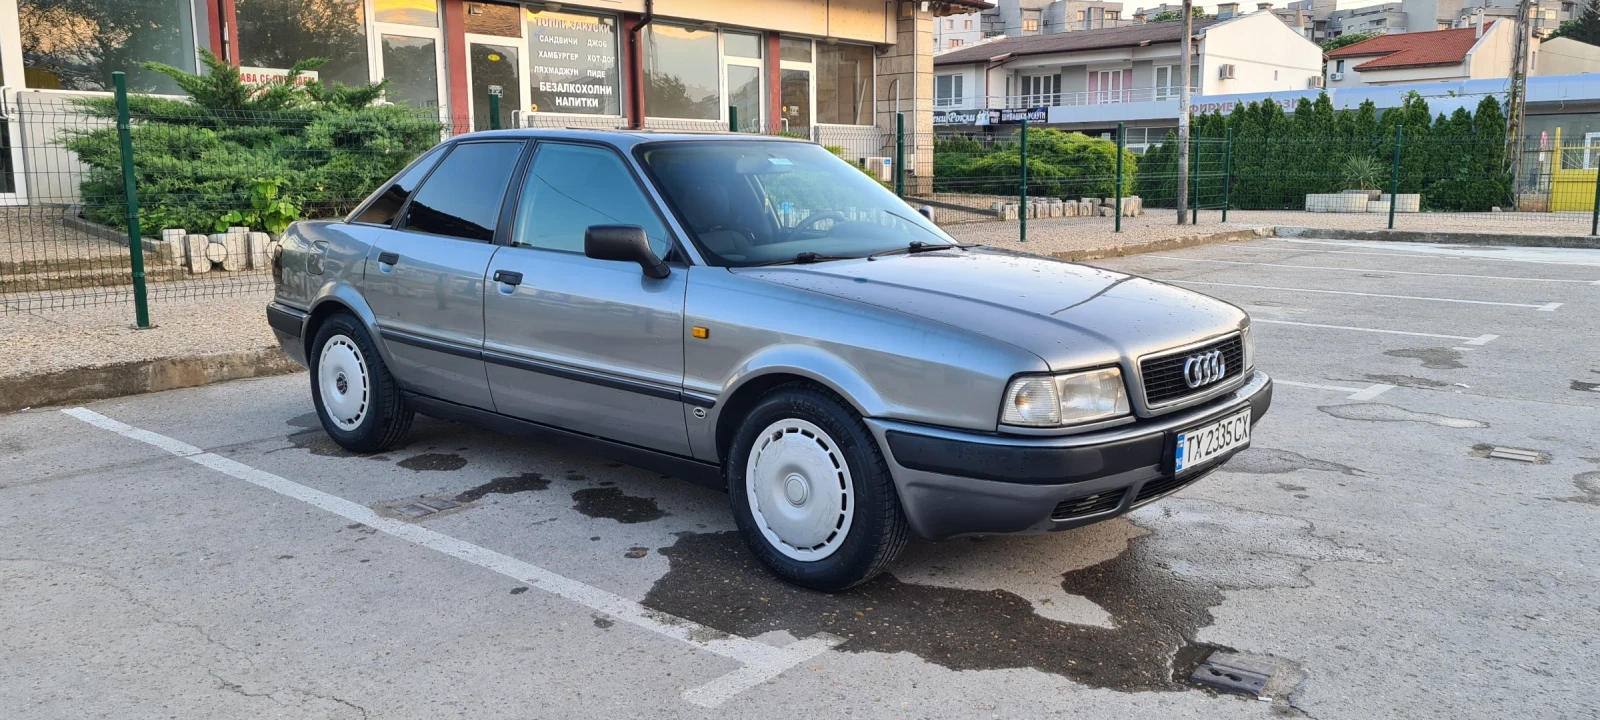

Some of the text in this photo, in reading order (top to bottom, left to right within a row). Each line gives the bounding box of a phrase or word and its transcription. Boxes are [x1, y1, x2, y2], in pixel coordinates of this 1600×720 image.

[535, 17, 610, 34] ТОПЛИ ЗАКУСКИ
[539, 34, 608, 48] САНДВИЧИ ДЖОБ
[538, 50, 615, 64] ХАМБУРГЕР ХОТ-ДОГ
[240, 72, 257, 83] АВА
[533, 65, 606, 79] ЛЯХМАДЖУН ПИДЕ
[539, 81, 613, 96] БЕЗАЛКОХОЛНИ
[555, 96, 599, 108] НАПИТКИ
[1187, 413, 1249, 463] TX 2335 CX
